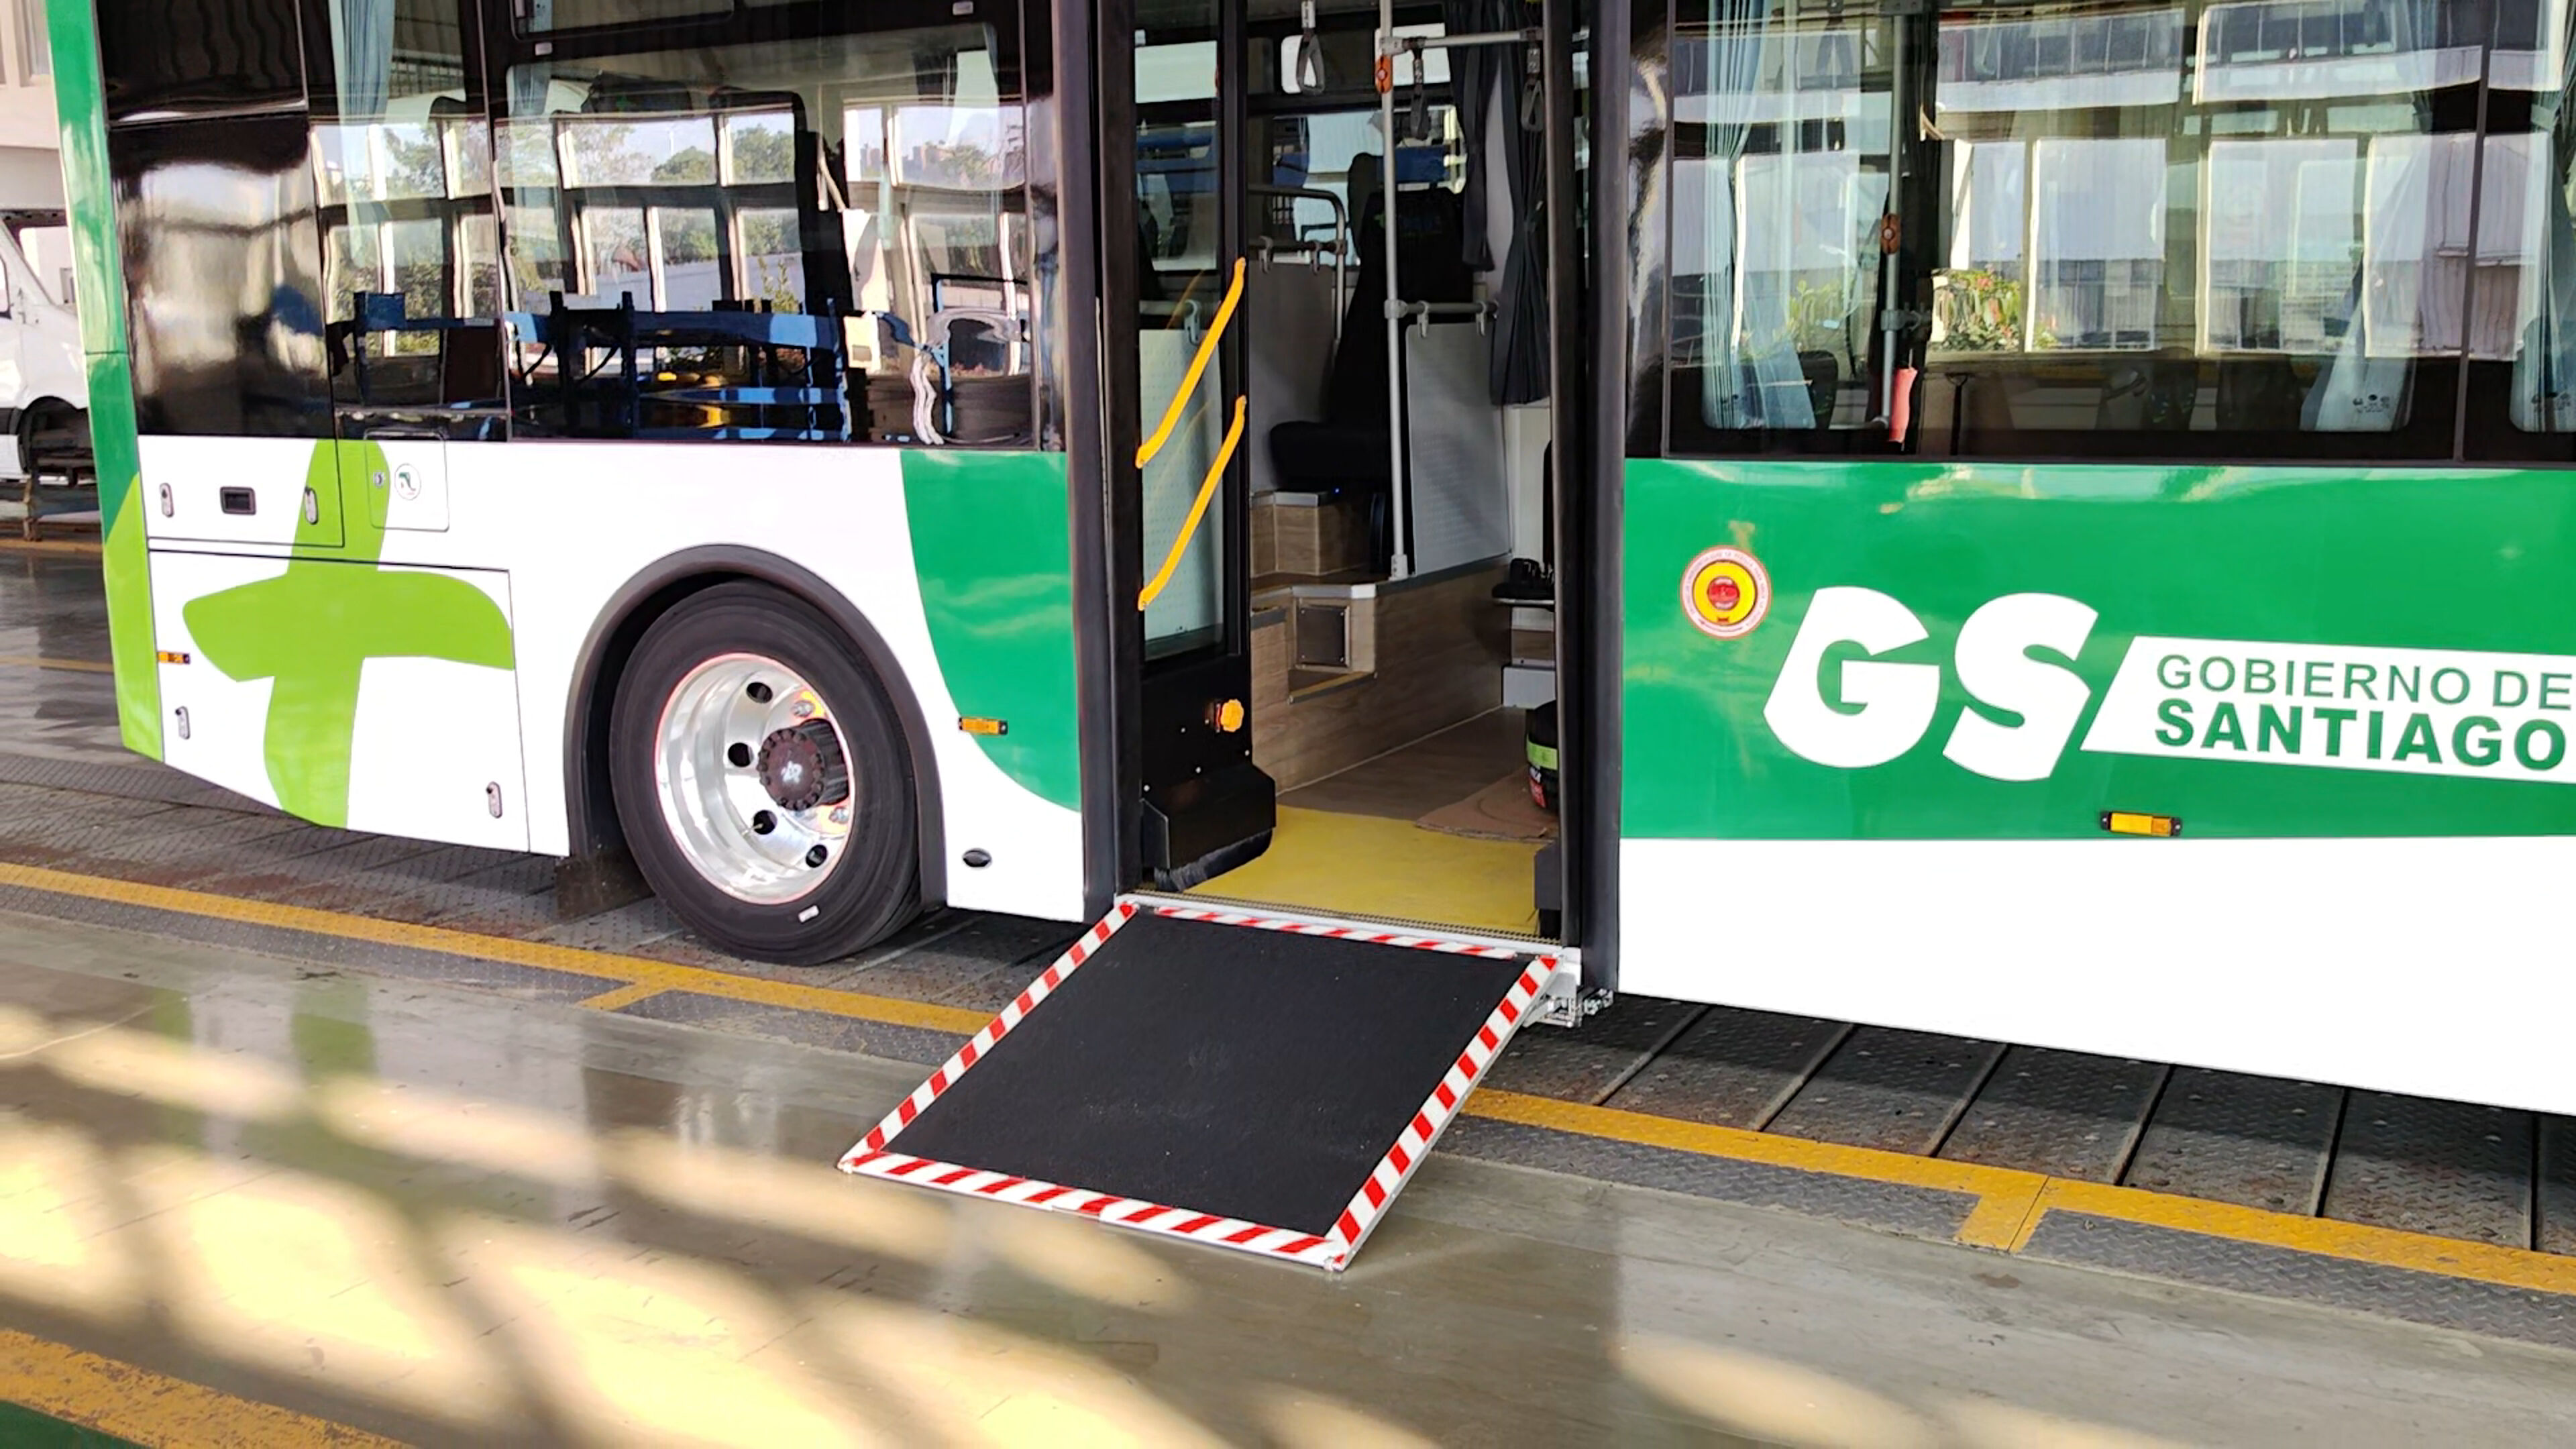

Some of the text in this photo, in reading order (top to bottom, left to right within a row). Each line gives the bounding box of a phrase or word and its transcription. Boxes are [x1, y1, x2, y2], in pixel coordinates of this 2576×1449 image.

[1762, 585, 2098, 782] GS
[2156, 655, 2573, 710] GOBIERNO DE
[2155, 698, 2567, 771] SANTIAGO
